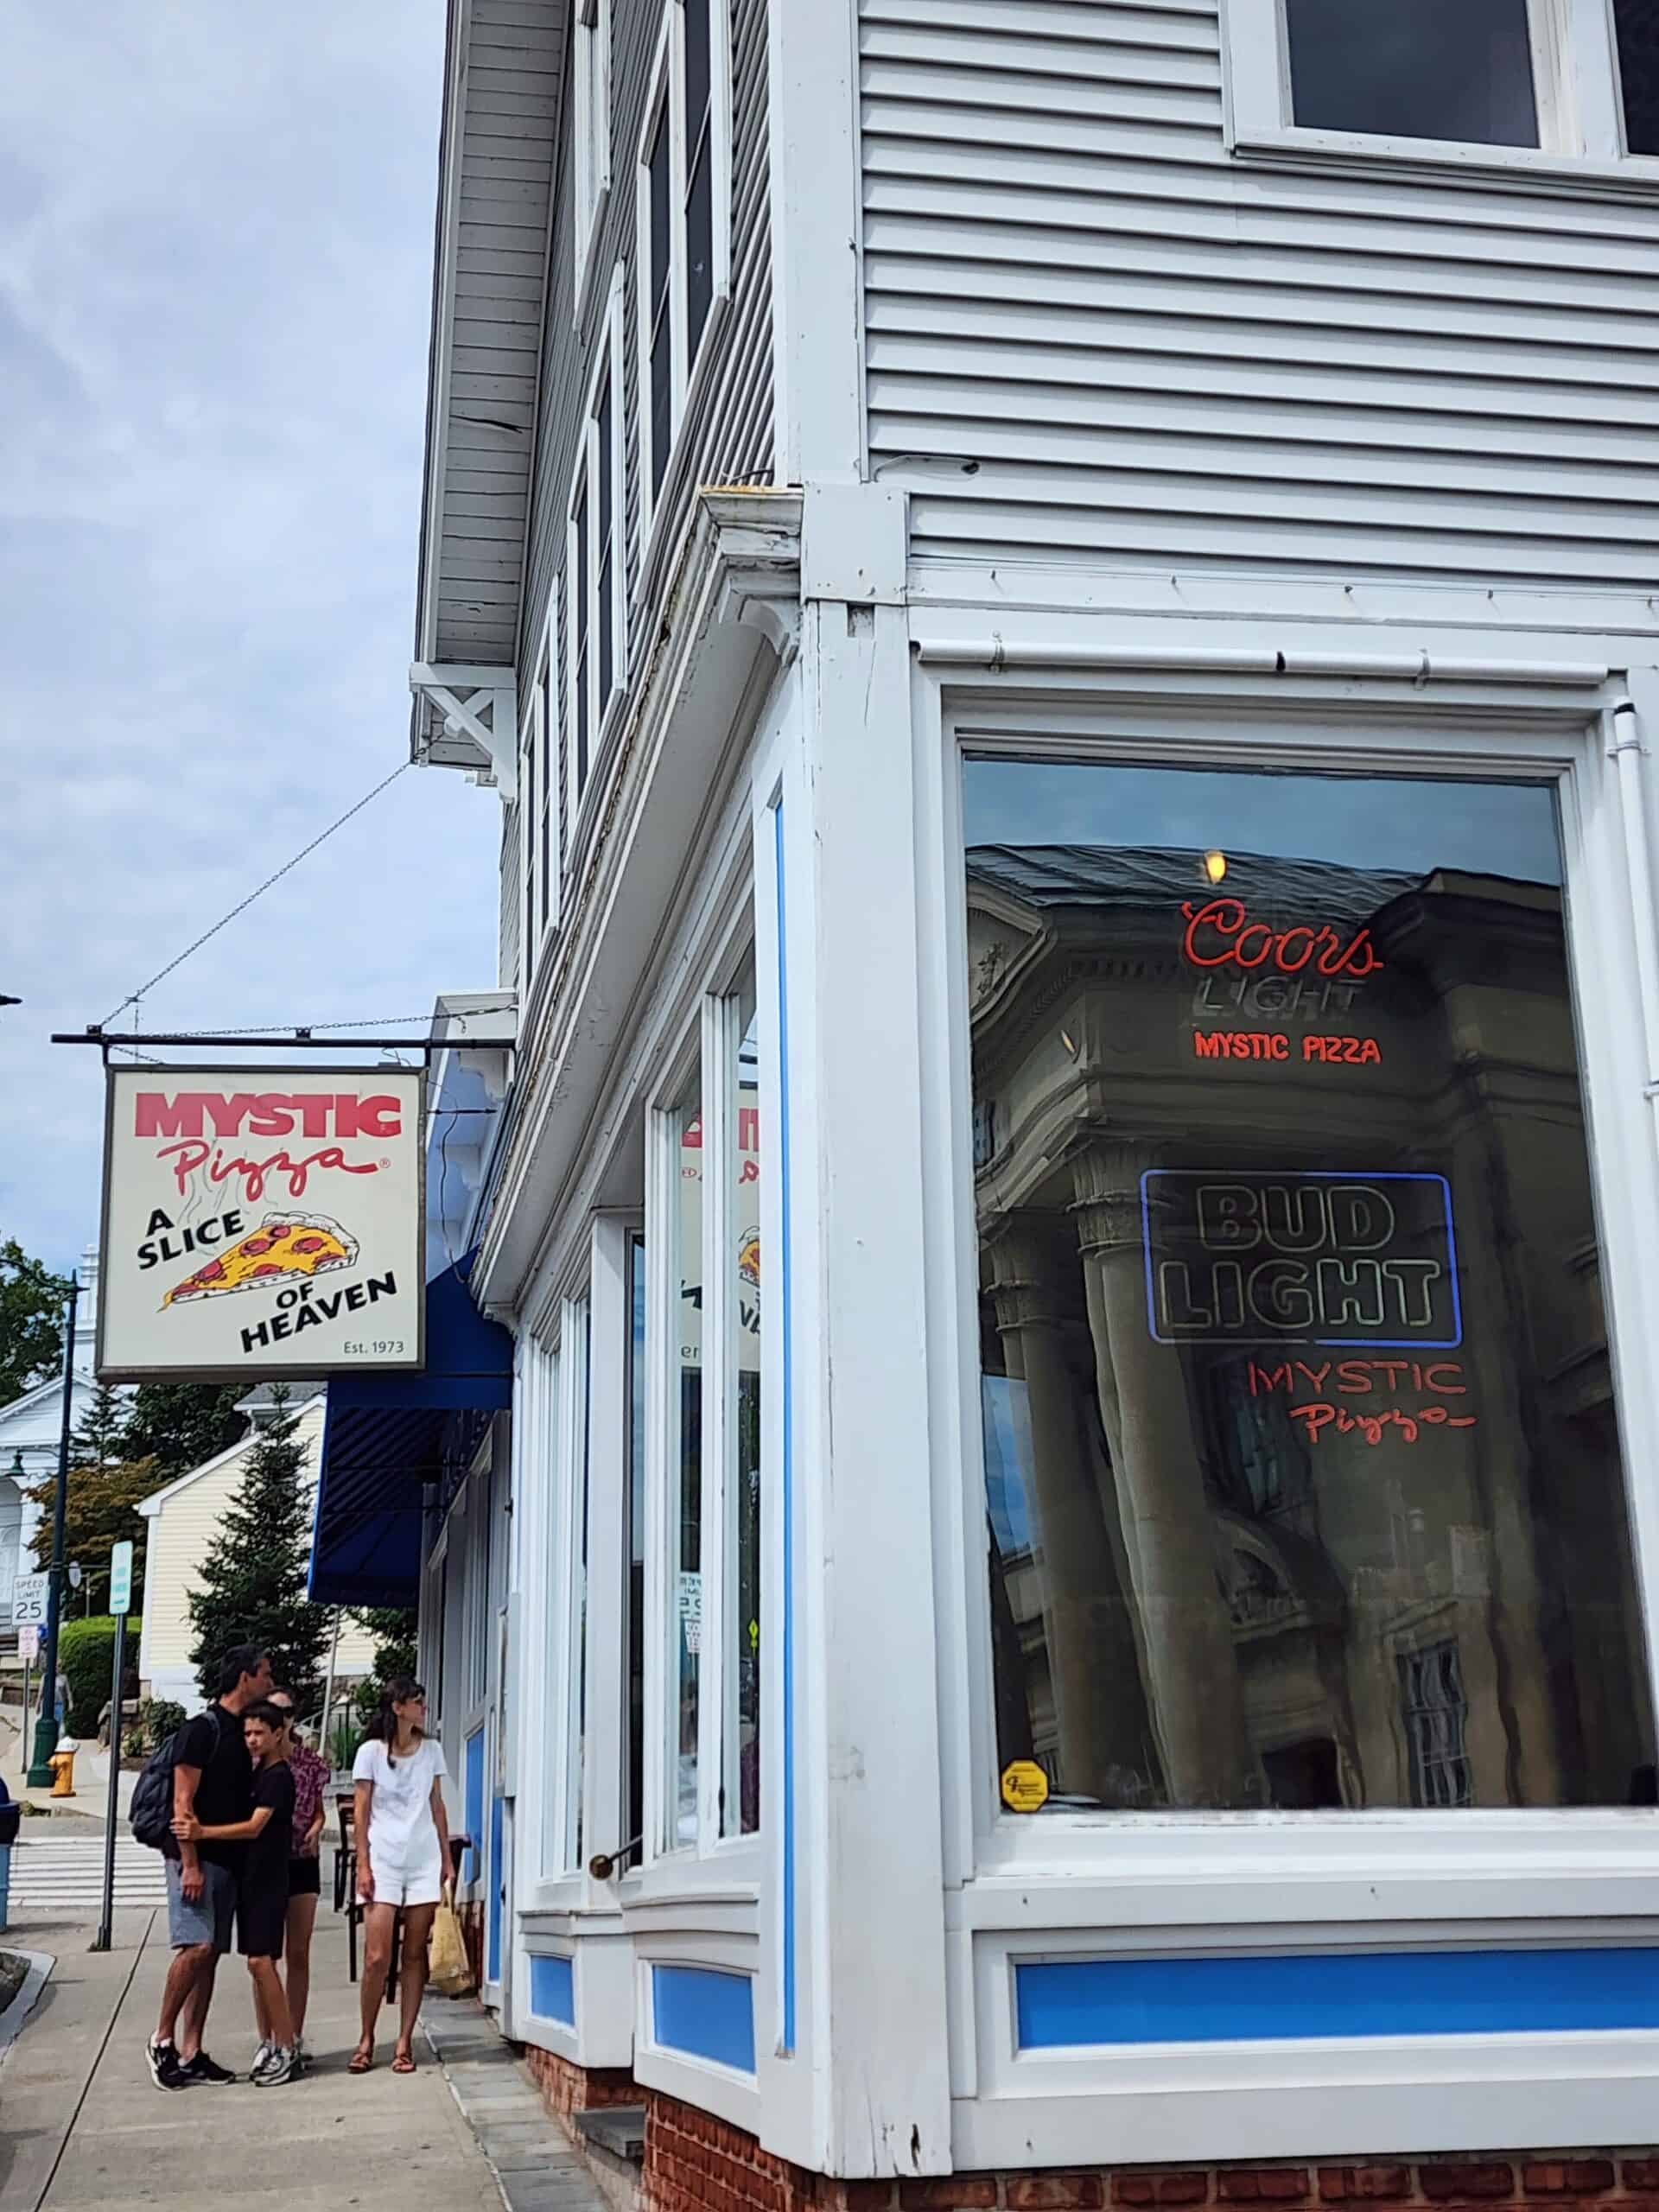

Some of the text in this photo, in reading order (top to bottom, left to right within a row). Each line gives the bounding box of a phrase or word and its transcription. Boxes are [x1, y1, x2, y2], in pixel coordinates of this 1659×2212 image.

[1181, 898, 1383, 976] Coors
[1196, 976, 1366, 1015] LIGHT
[1194, 1031, 1382, 1065] MYSTIC PIZZA
[135, 1092, 402, 1139] MYSTIC
[145, 1208, 175, 1237] A
[1197, 1185, 1395, 1251] BUD
[137, 1209, 245, 1270] SLICE
[240, 1271, 397, 1354] HEAVEN
[276, 1281, 315, 1310] OF
[1160, 1259, 1440, 1329] LIGHT
[344, 1341, 404, 1354] Est. 1973
[1248, 1361, 1466, 1396] MYSTIC
[1289, 1403, 1478, 1445] Pizza
[15, 1579, 43, 1588] SPEED
[15, 1601, 41, 1619] 25
